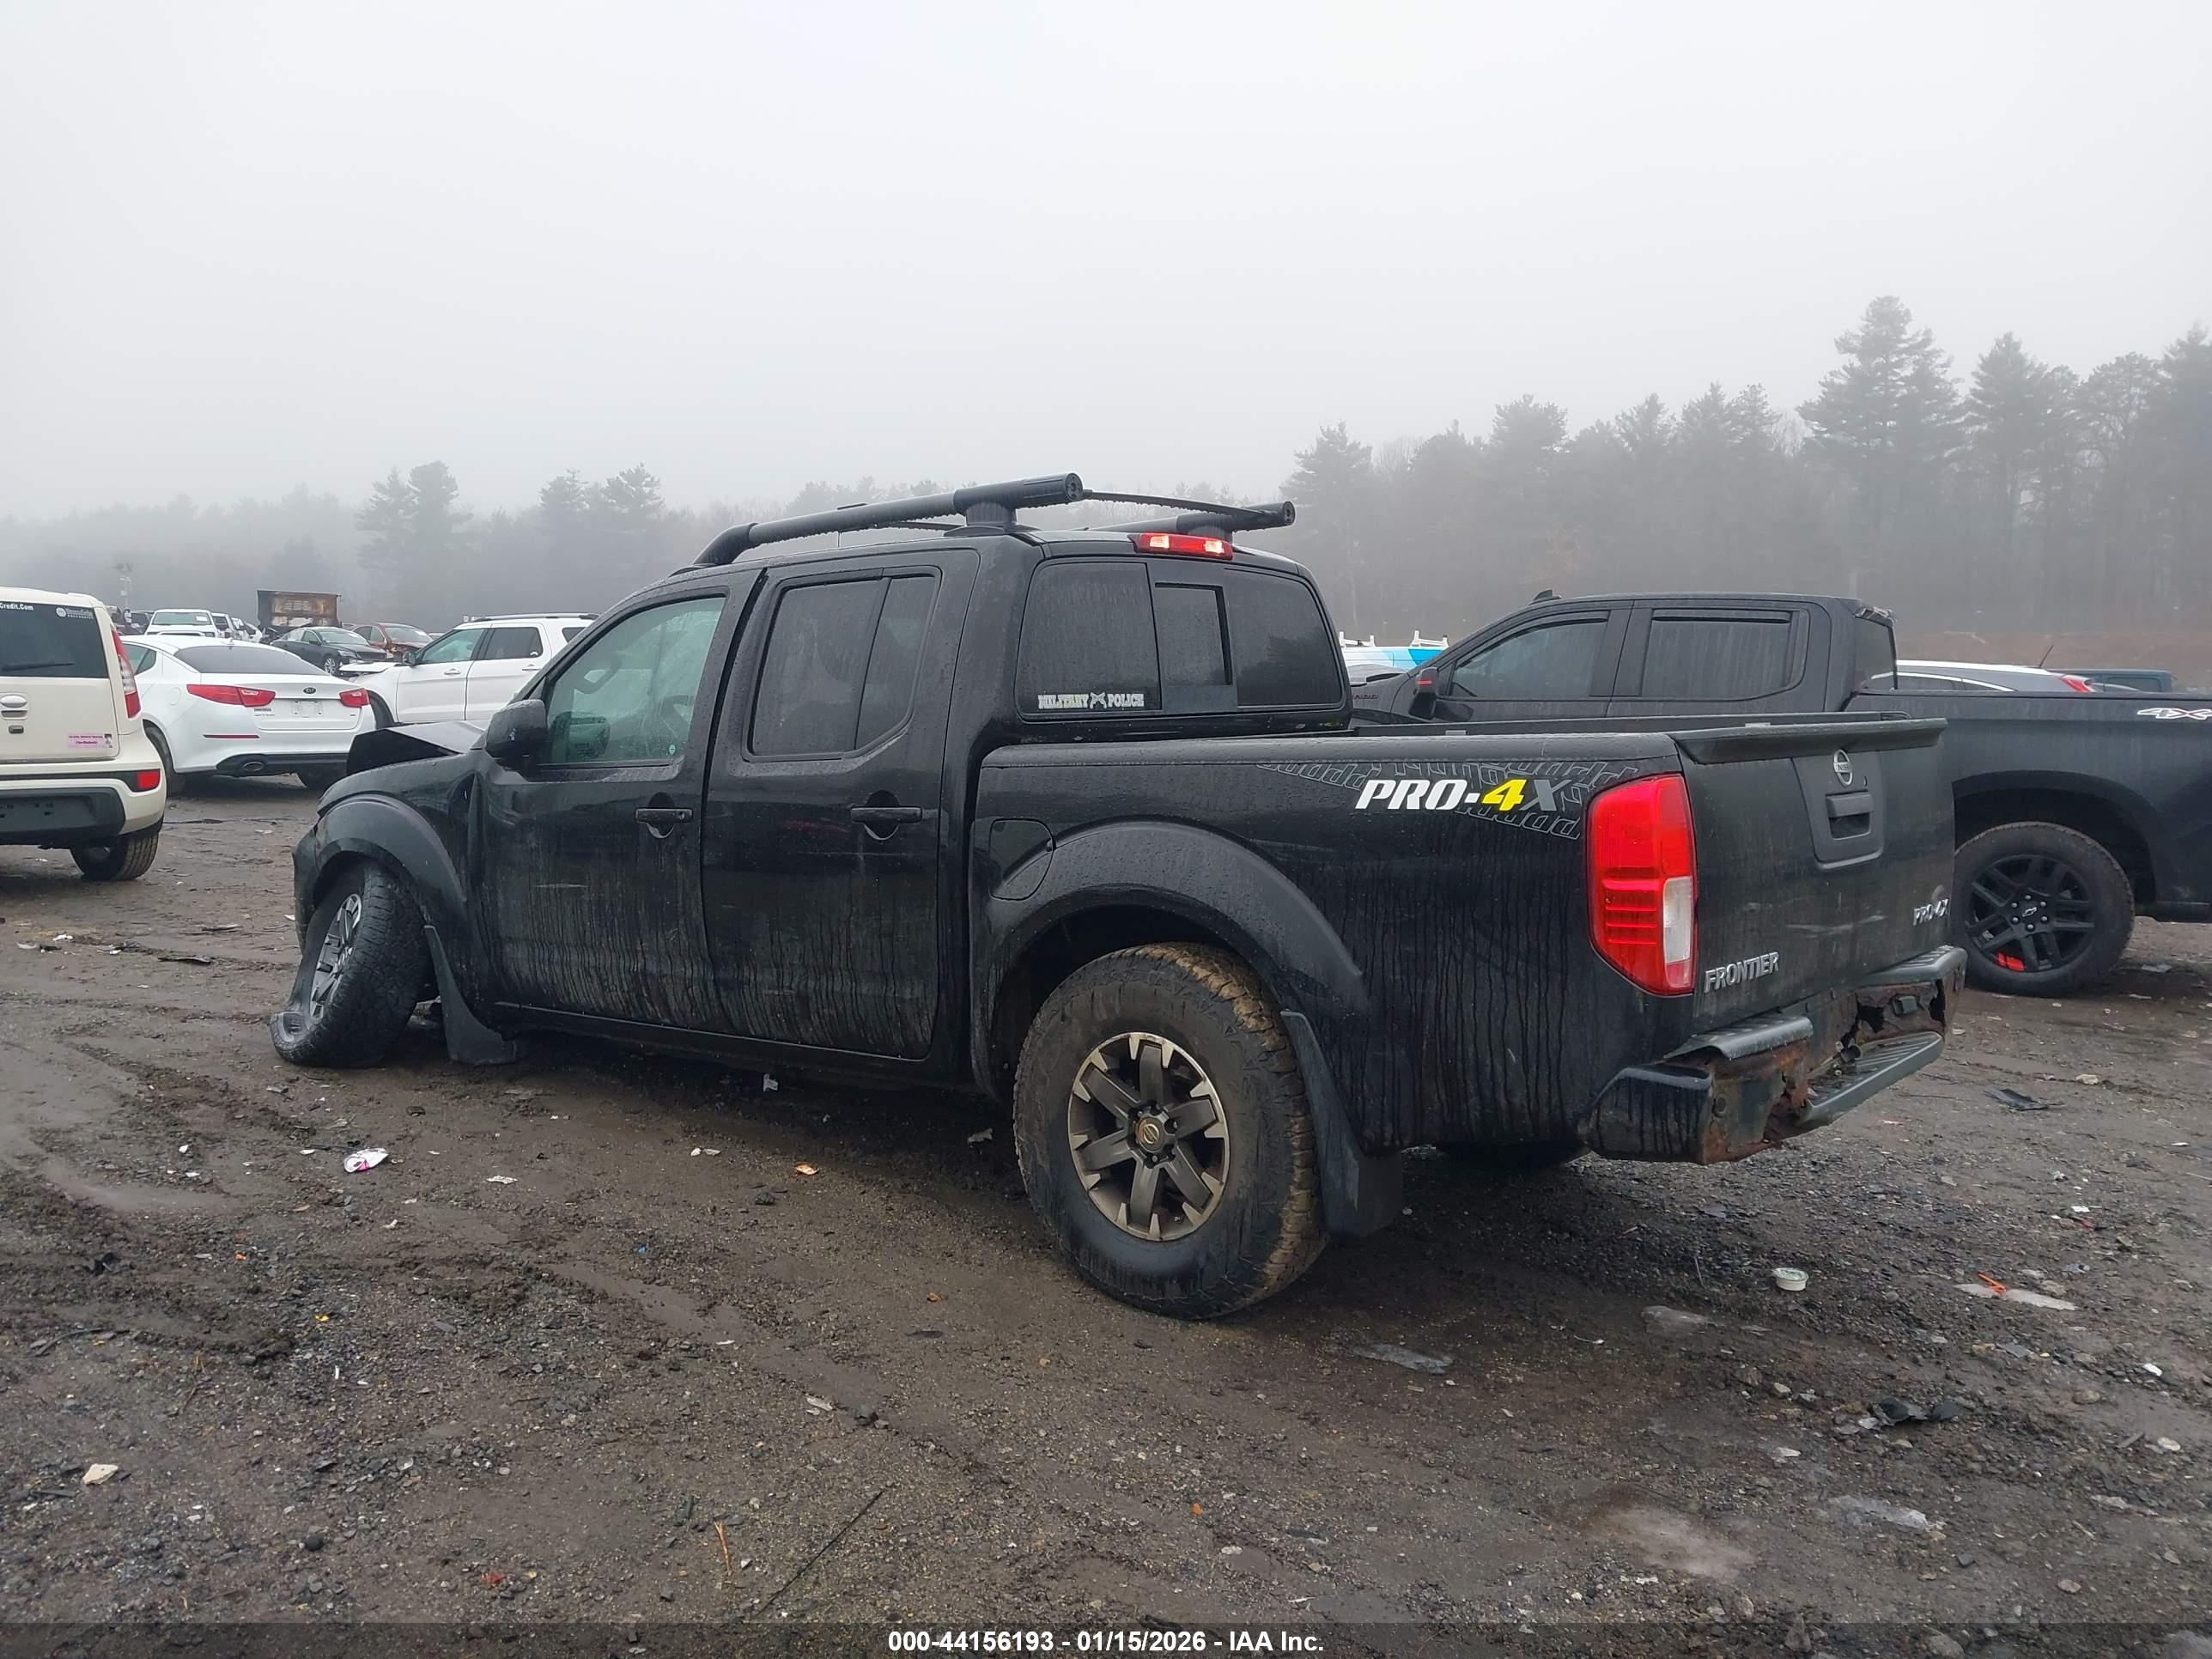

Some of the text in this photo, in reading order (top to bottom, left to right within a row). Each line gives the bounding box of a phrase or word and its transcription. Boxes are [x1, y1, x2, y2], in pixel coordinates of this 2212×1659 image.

[1037, 693, 1145, 709] MILITARY POLICE
[1355, 779, 1570, 811] PRO-4X
[1704, 951, 1779, 994] FRONTIER
